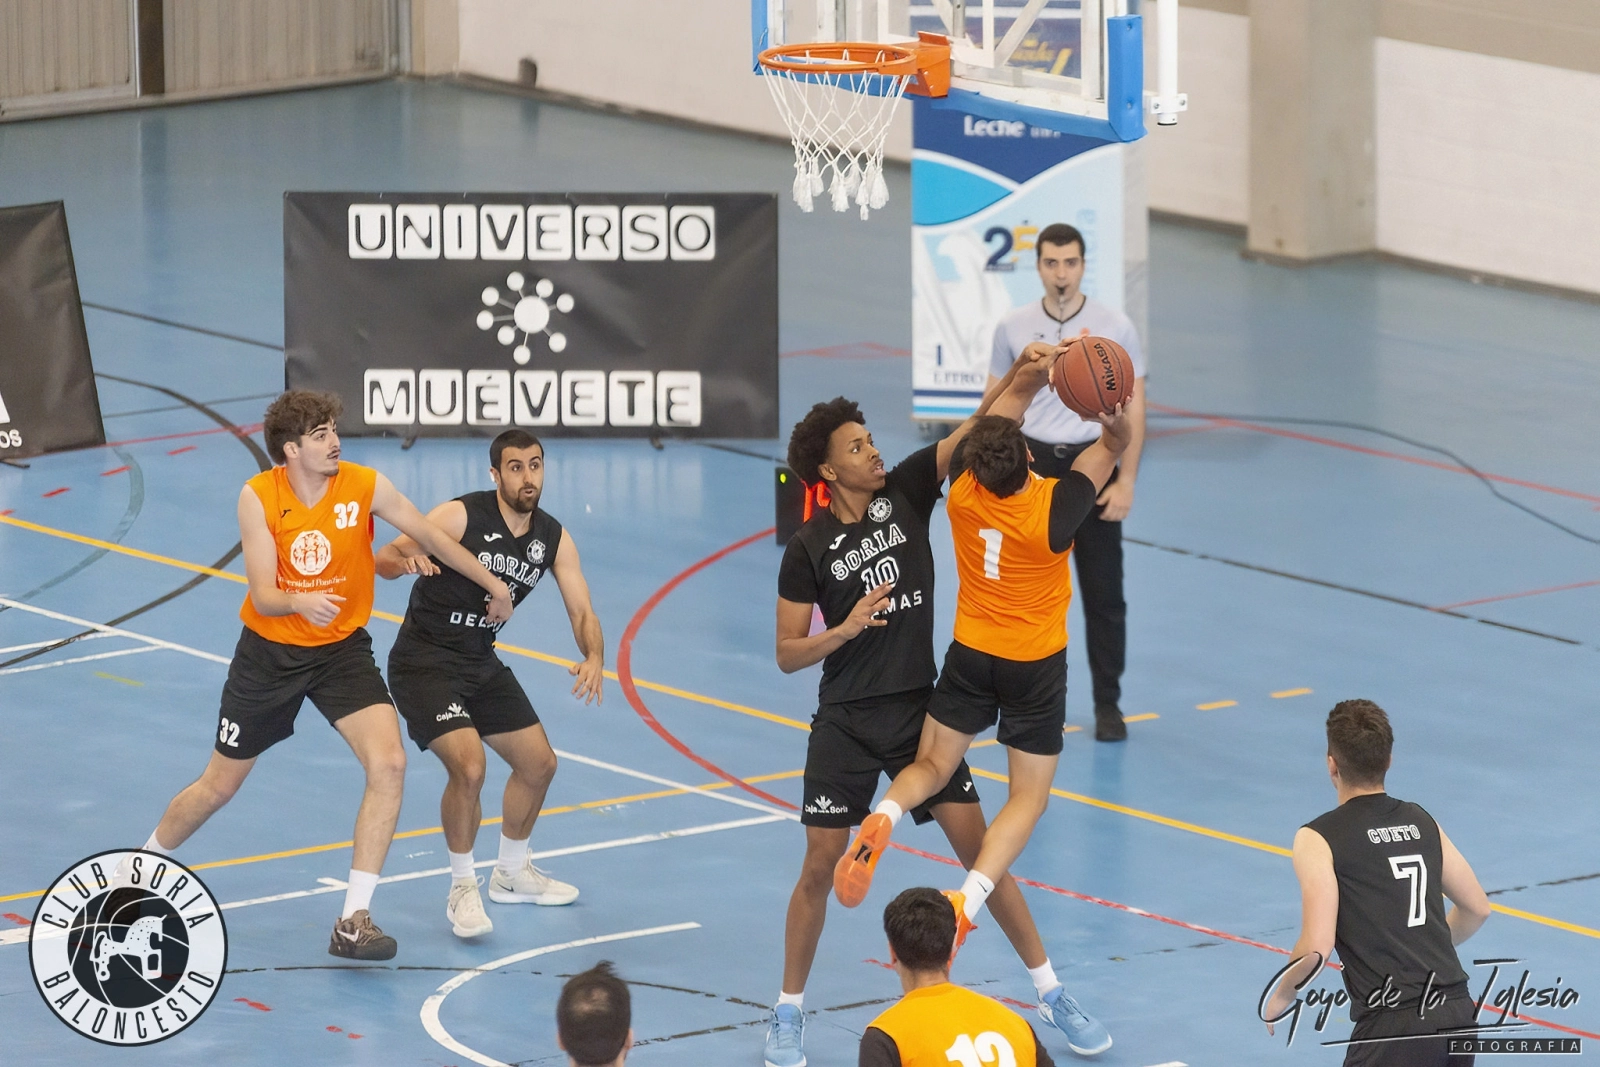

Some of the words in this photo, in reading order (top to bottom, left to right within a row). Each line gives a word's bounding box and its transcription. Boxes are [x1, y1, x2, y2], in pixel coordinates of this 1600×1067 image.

[350, 207, 714, 257] UNIVERSO
[366, 372, 699, 425] MUÉVETE
[334, 501, 360, 530] 32
[478, 552, 540, 588] SORIA
[831, 523, 907, 581] SORIA
[978, 528, 1003, 580] 1
[861, 556, 900, 596] 10
[220, 717, 240, 748] 32
[1367, 824, 1421, 844] CUETO
[1388, 854, 1428, 928] 7
